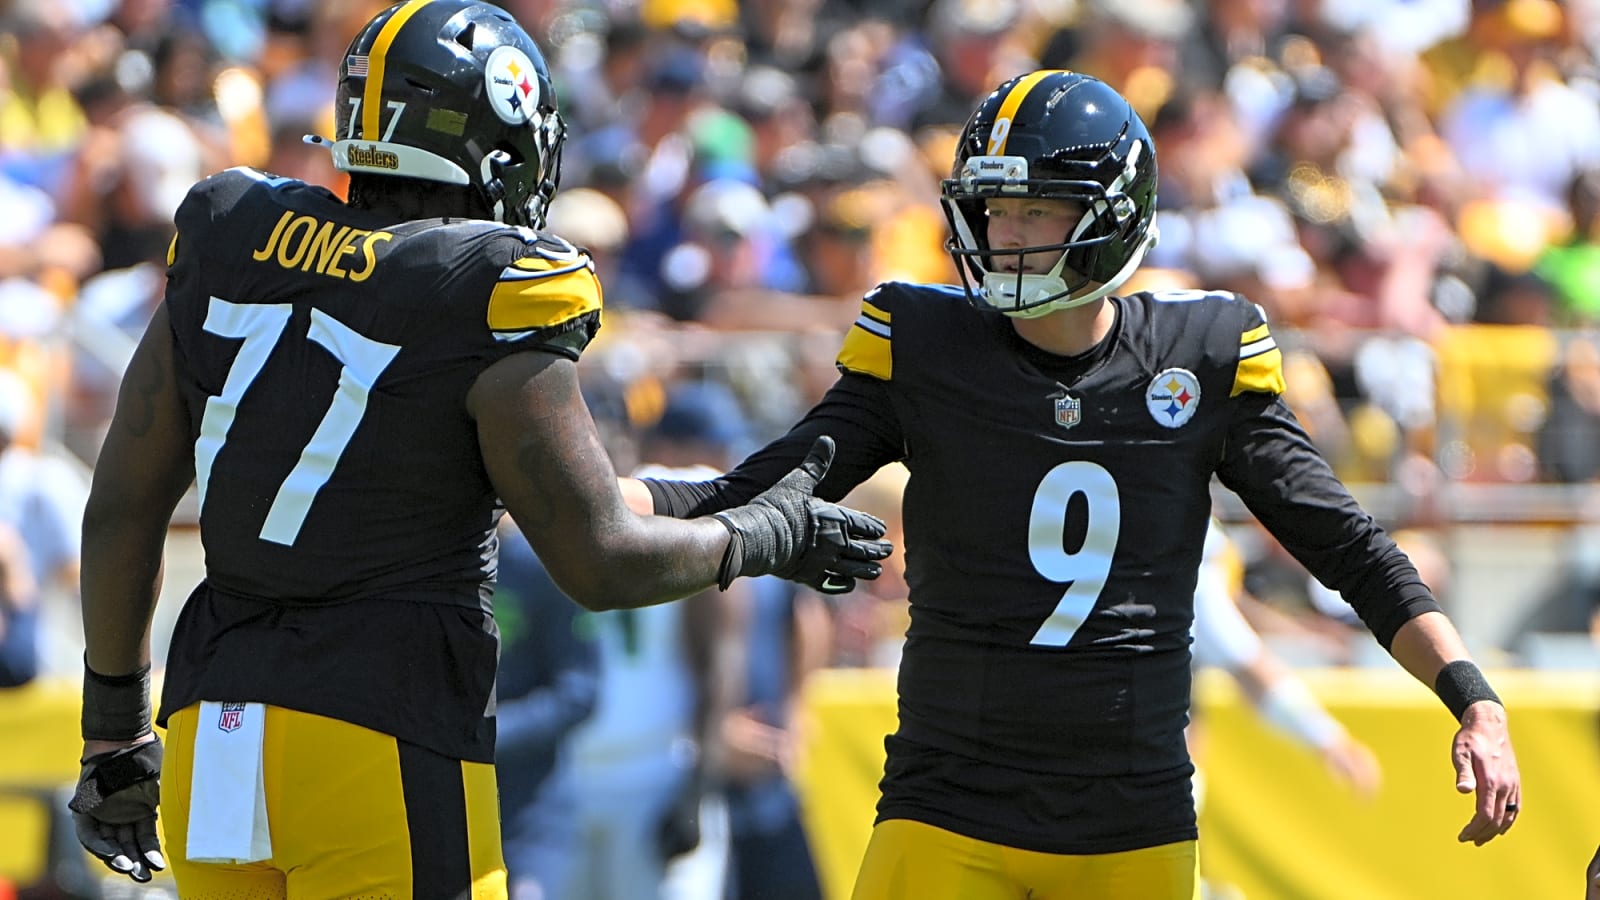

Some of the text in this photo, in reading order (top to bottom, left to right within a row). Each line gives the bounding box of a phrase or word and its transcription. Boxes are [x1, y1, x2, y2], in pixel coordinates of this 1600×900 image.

[990, 118, 1010, 155] 9
[347, 143, 399, 169] Steelers
[980, 160, 1003, 170] Steelers
[252, 210, 393, 282] JONES
[194, 295, 402, 547] 77
[1060, 411, 1077, 422] NFL
[1028, 460, 1121, 648] 9
[221, 711, 240, 729] NFL
